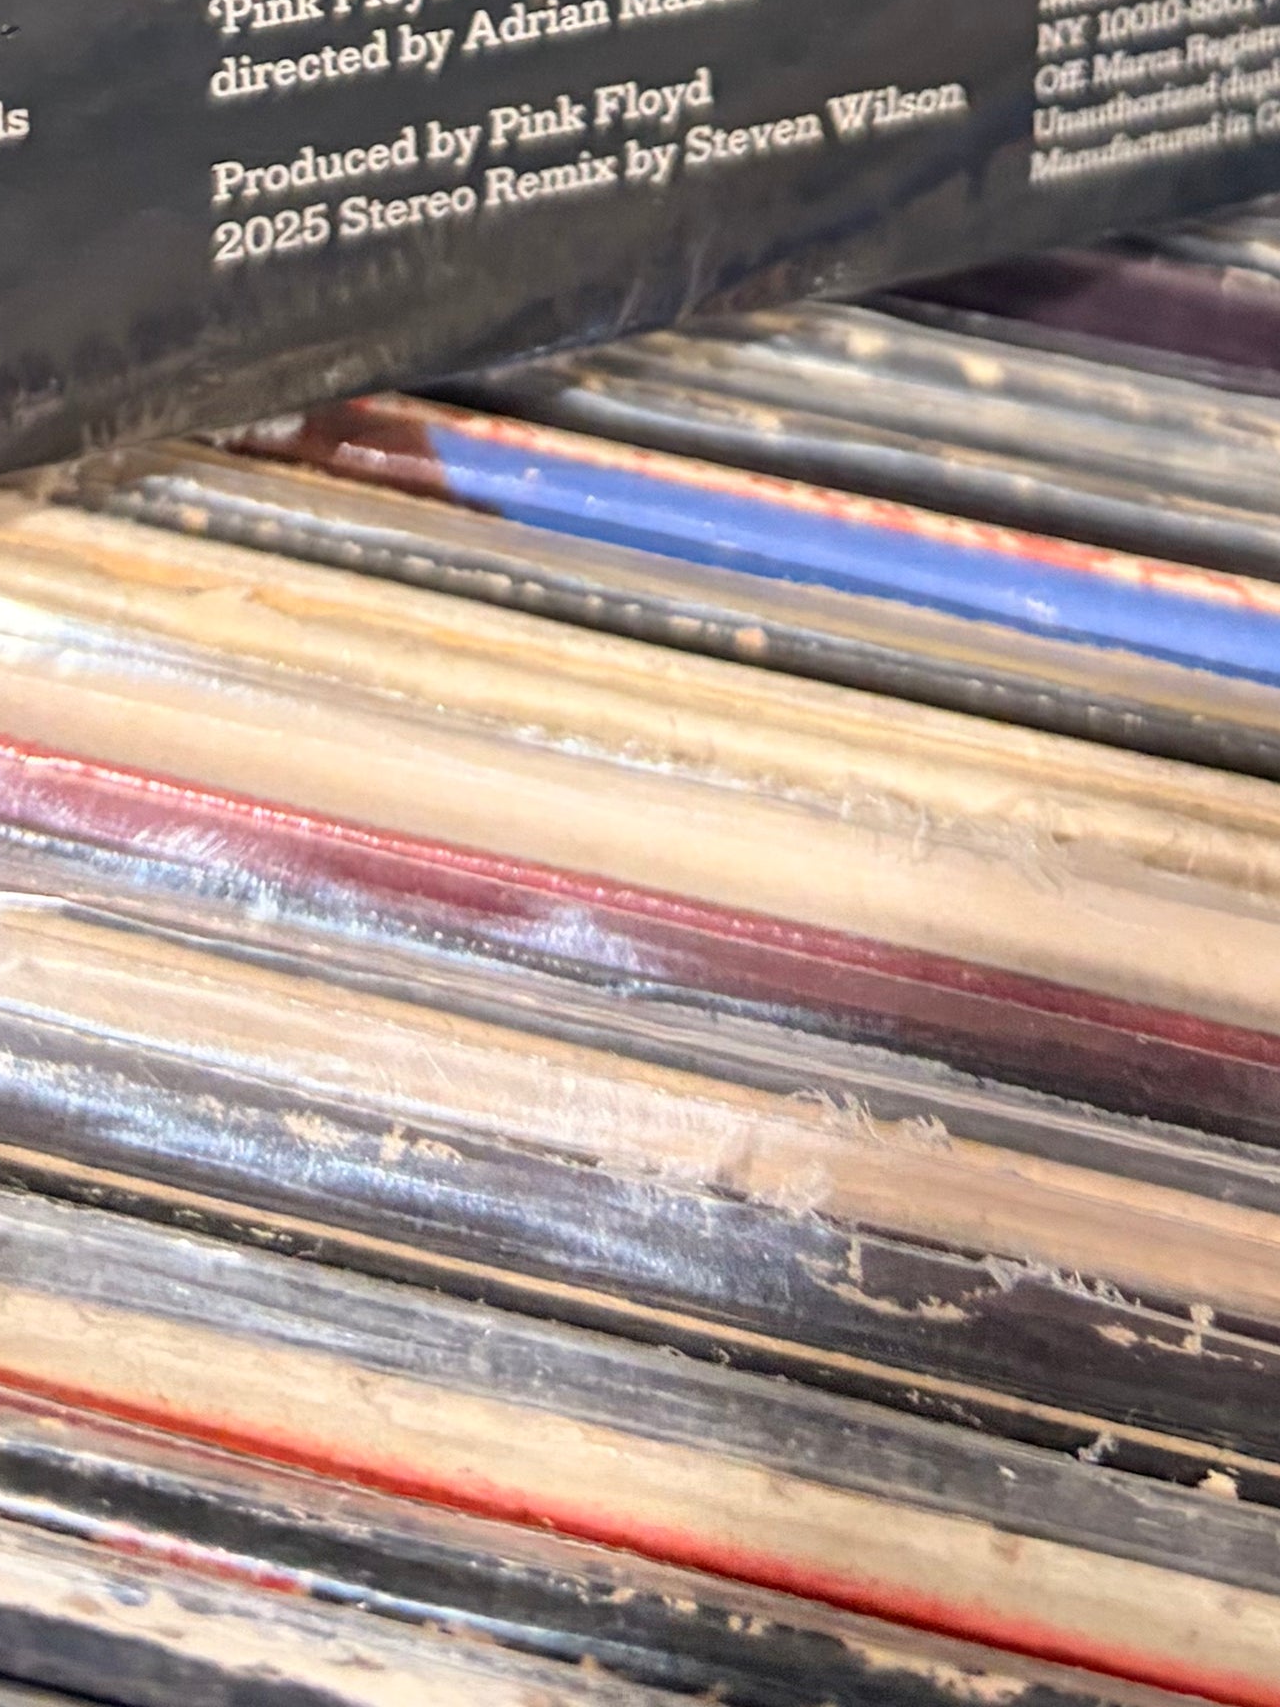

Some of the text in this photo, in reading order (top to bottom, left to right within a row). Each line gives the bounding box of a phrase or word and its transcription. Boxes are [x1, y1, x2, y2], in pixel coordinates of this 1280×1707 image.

[211, 35, 389, 98] directed
[399, 25, 453, 70] by
[1037, 15, 1090, 53] NY
[212, 68, 712, 204] Produced by Pink Floyd
[1029, 117, 1219, 184] Manufactured
[215, 84, 966, 264] 2025 Stereo Remix by Steven Wilson
